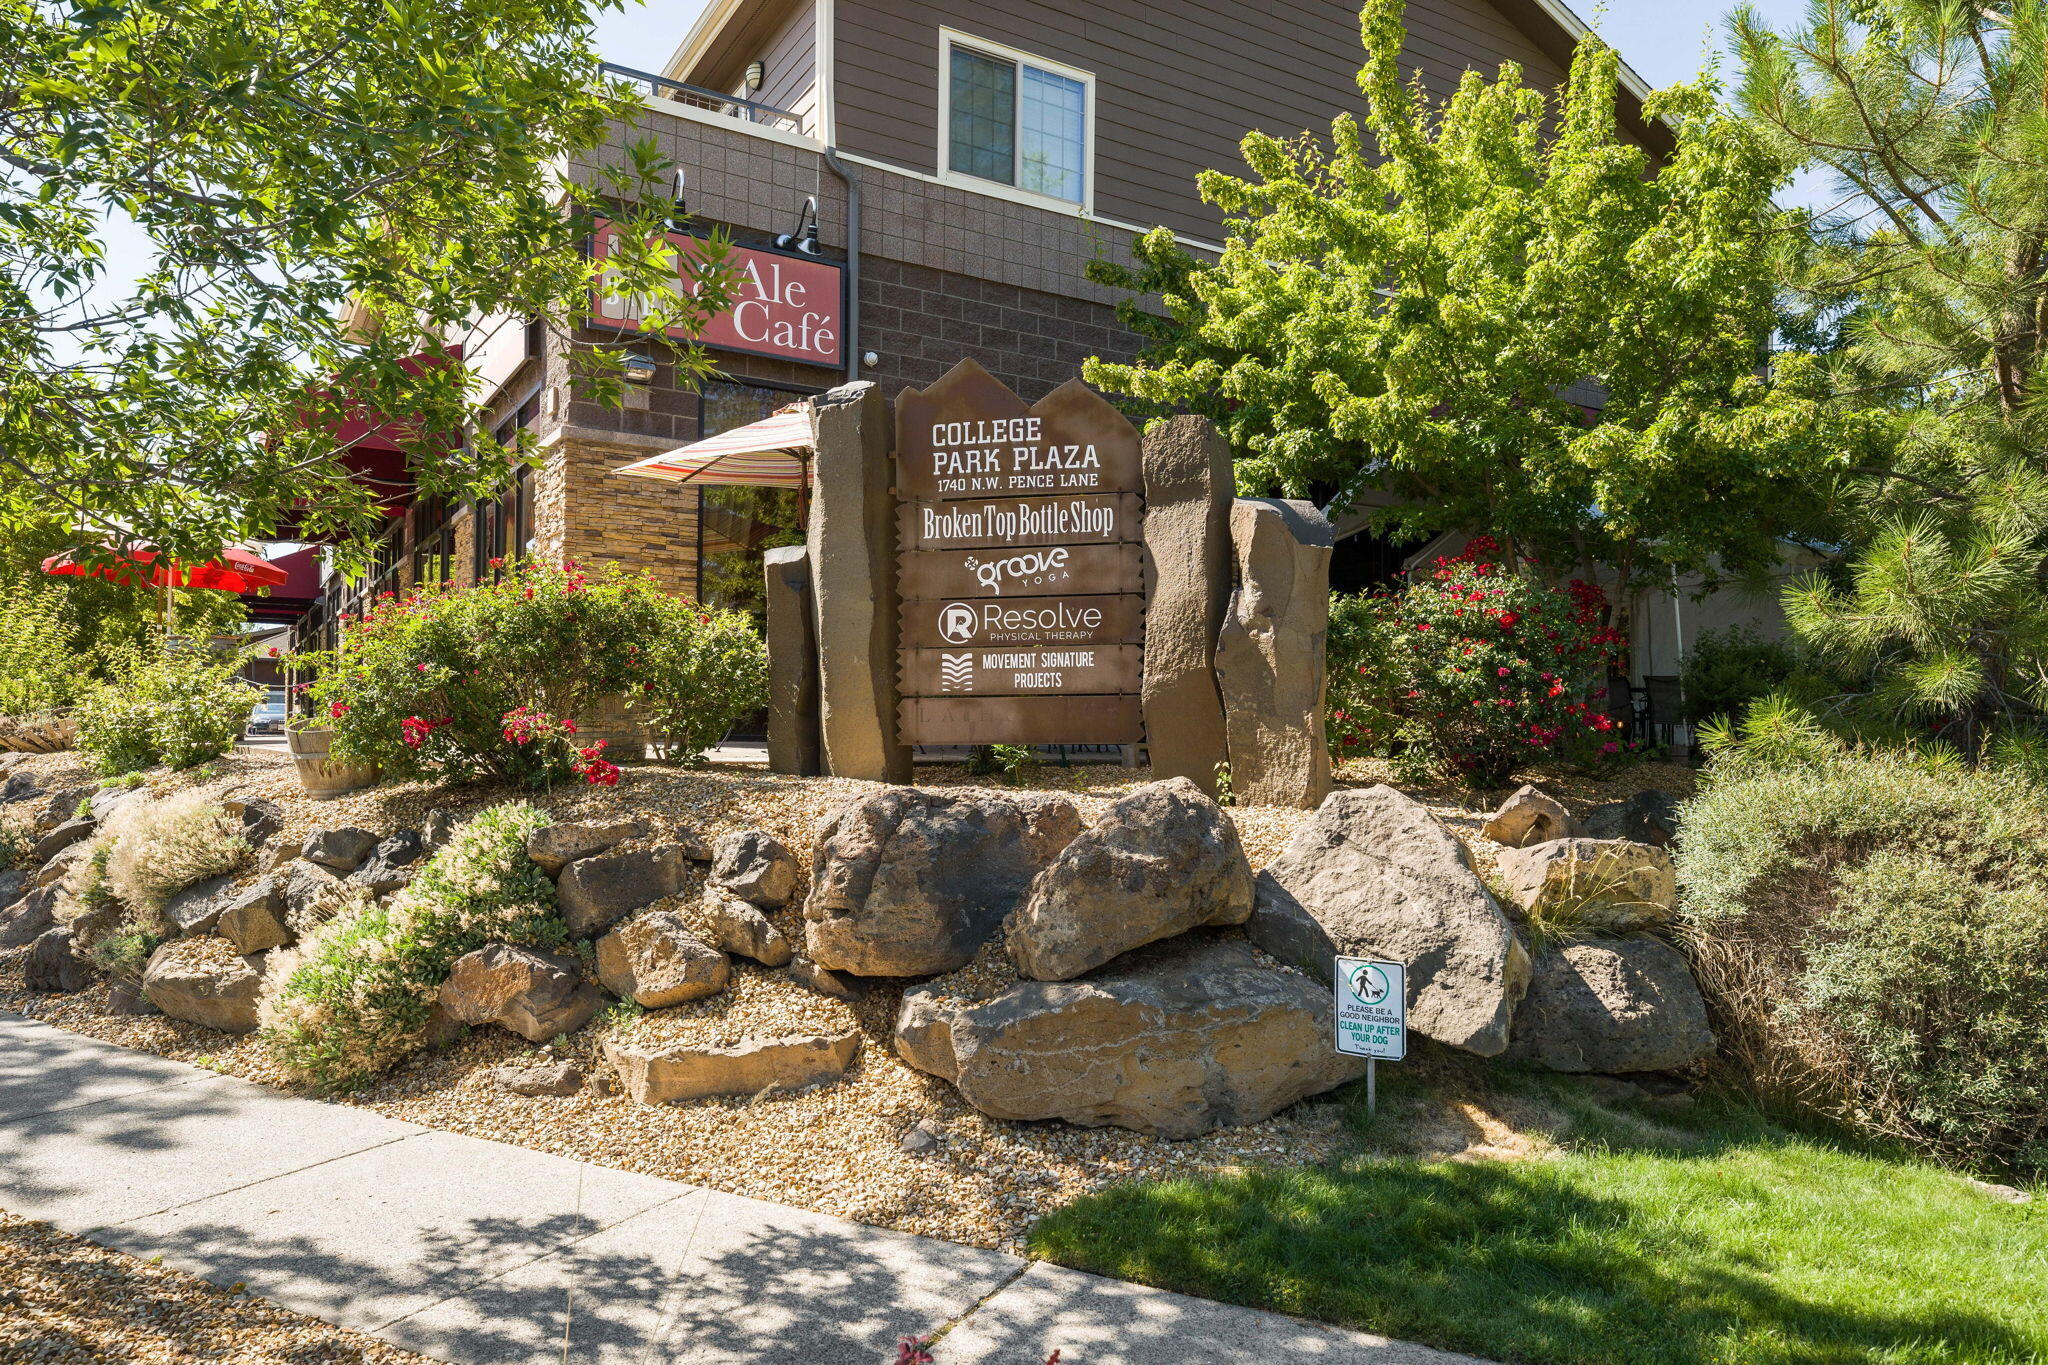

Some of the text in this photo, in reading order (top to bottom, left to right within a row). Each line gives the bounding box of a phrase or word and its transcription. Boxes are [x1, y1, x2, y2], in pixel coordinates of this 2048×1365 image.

[731, 258, 806, 308] Ale
[733, 300, 835, 355] Café
[932, 417, 1042, 447] COLLEGE
[933, 444, 1101, 476] PARK PLAZA
[937, 473, 1099, 492] 1740 N.W. PENCE LANE
[923, 500, 1114, 541] Broken Top Bottle Shop
[976, 547, 1069, 596] groove
[1022, 570, 1070, 588] YOGA
[984, 602, 1102, 630] Resolve
[990, 630, 1094, 641] PHYSICAL THERAPY
[982, 651, 1095, 670] MOVEMENT SIGNATURE
[1014, 672, 1062, 689] PROJECTS
[1340, 1011, 1400, 1024] GOOD NEIGHBOR
[1348, 1004, 1374, 1014] PLEASE
[1340, 1020, 1400, 1036] CLEAN UP AFTER
[1351, 1032, 1388, 1044] YOUR DOG
